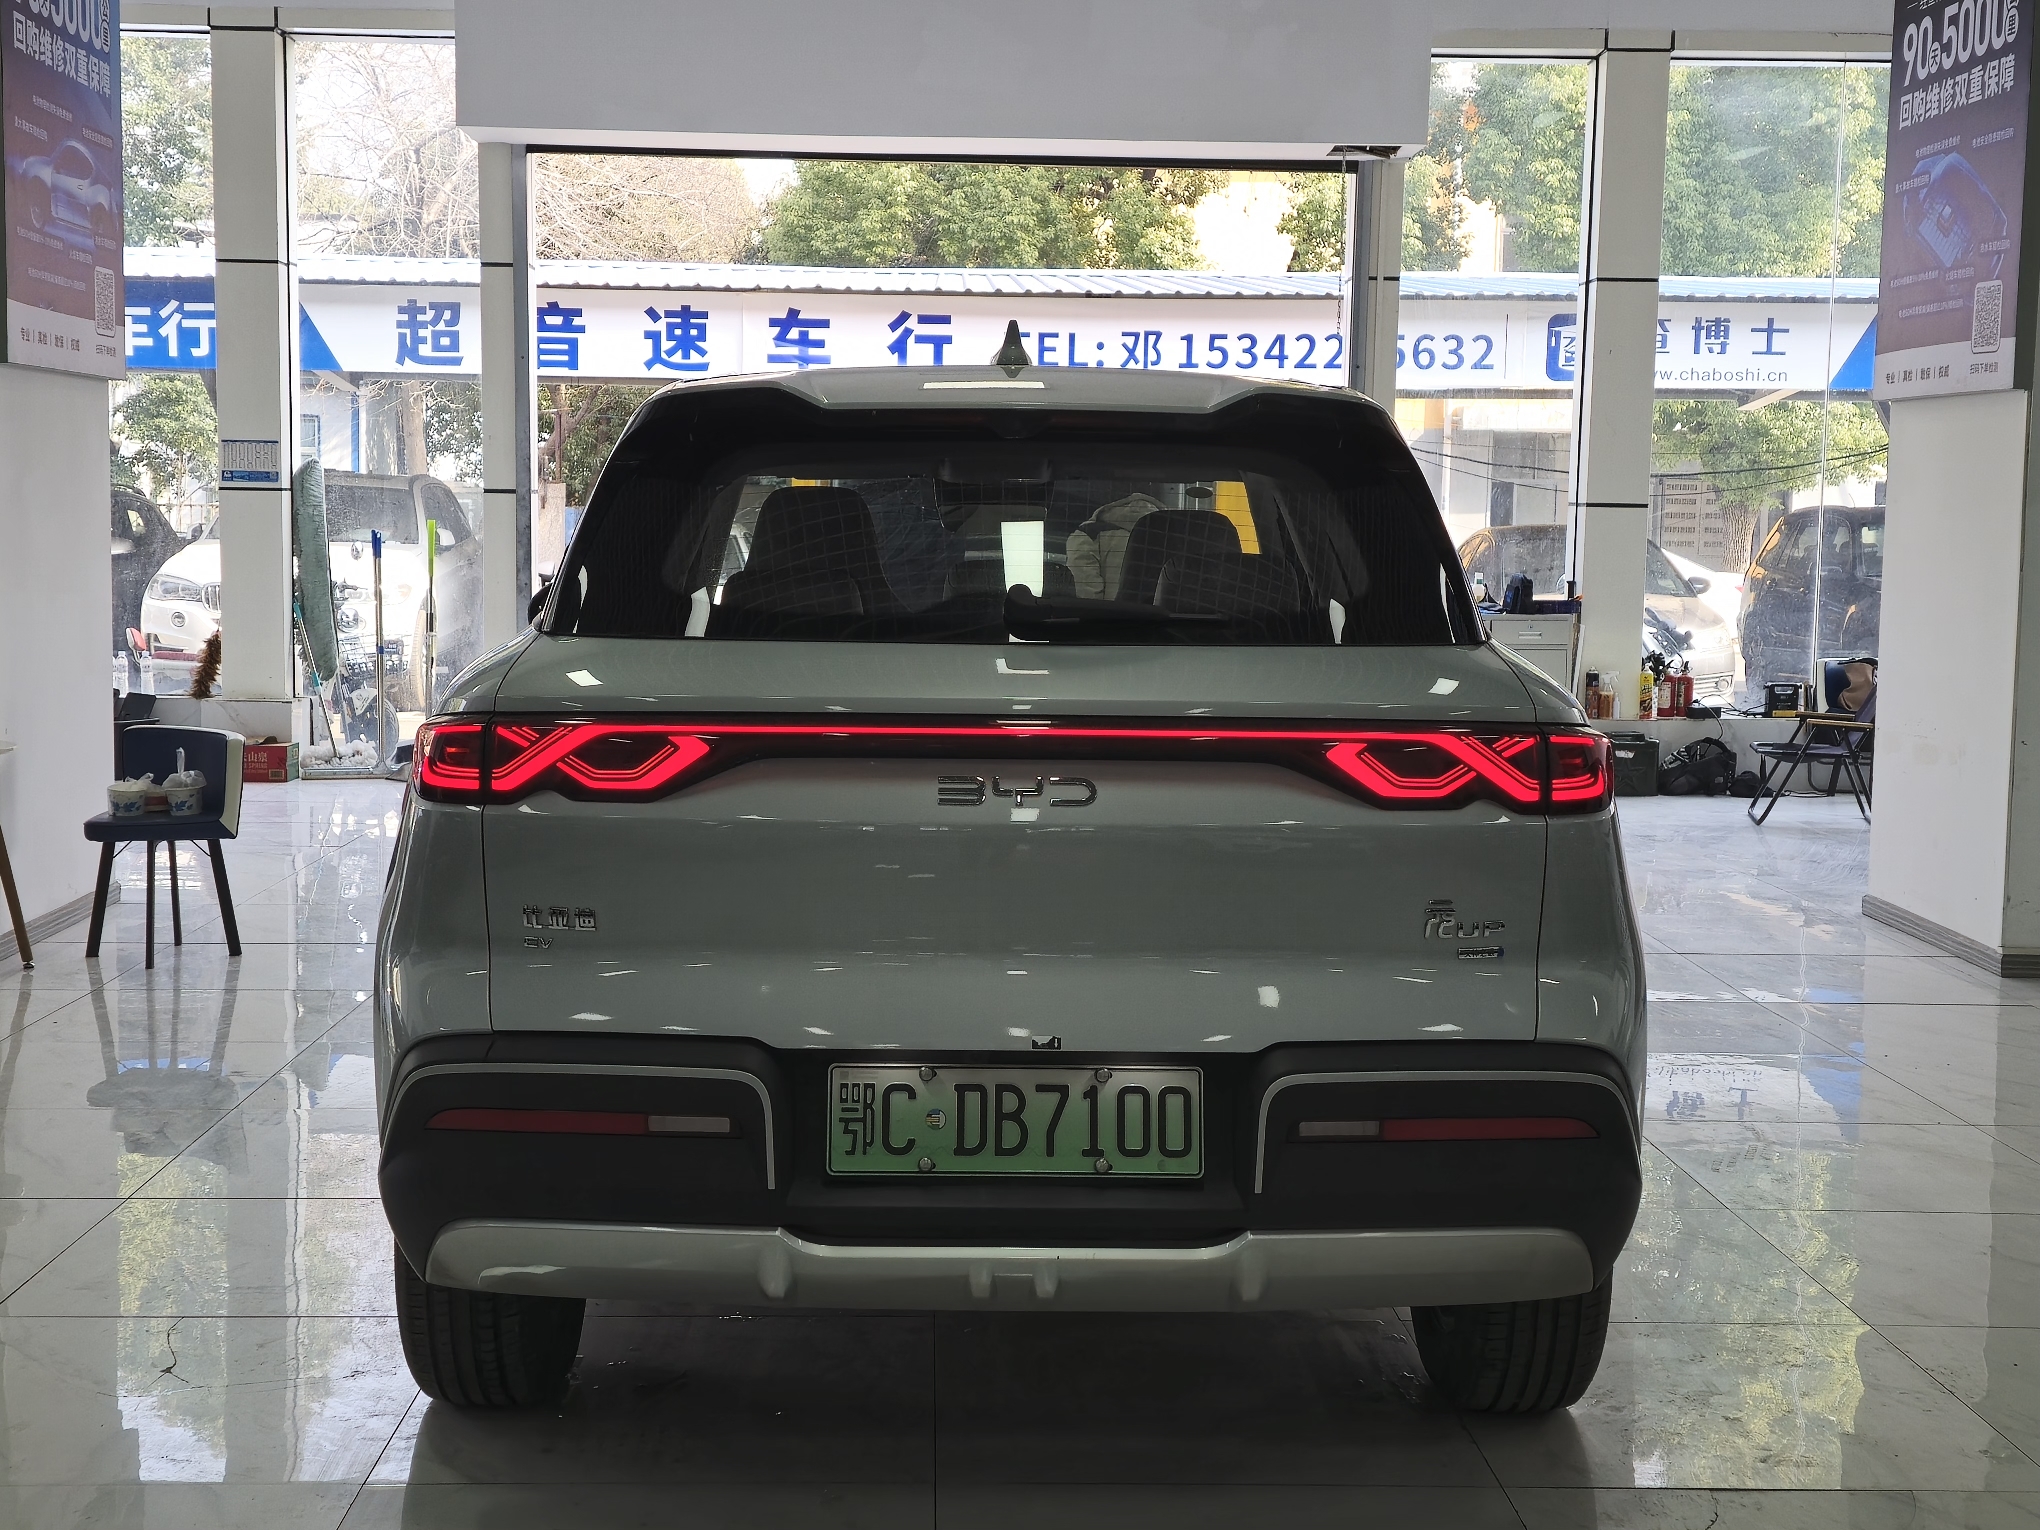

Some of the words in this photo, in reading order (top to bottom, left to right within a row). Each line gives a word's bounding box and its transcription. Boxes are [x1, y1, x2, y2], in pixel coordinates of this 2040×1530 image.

[13, 10, 111, 98] 回购维修双重保障
[1899, 52, 2016, 131] 回购维修双重保障
[938, 776, 1098, 807] BYD
[523, 904, 596, 931] 比亚迪
[523, 936, 553, 949] EV
